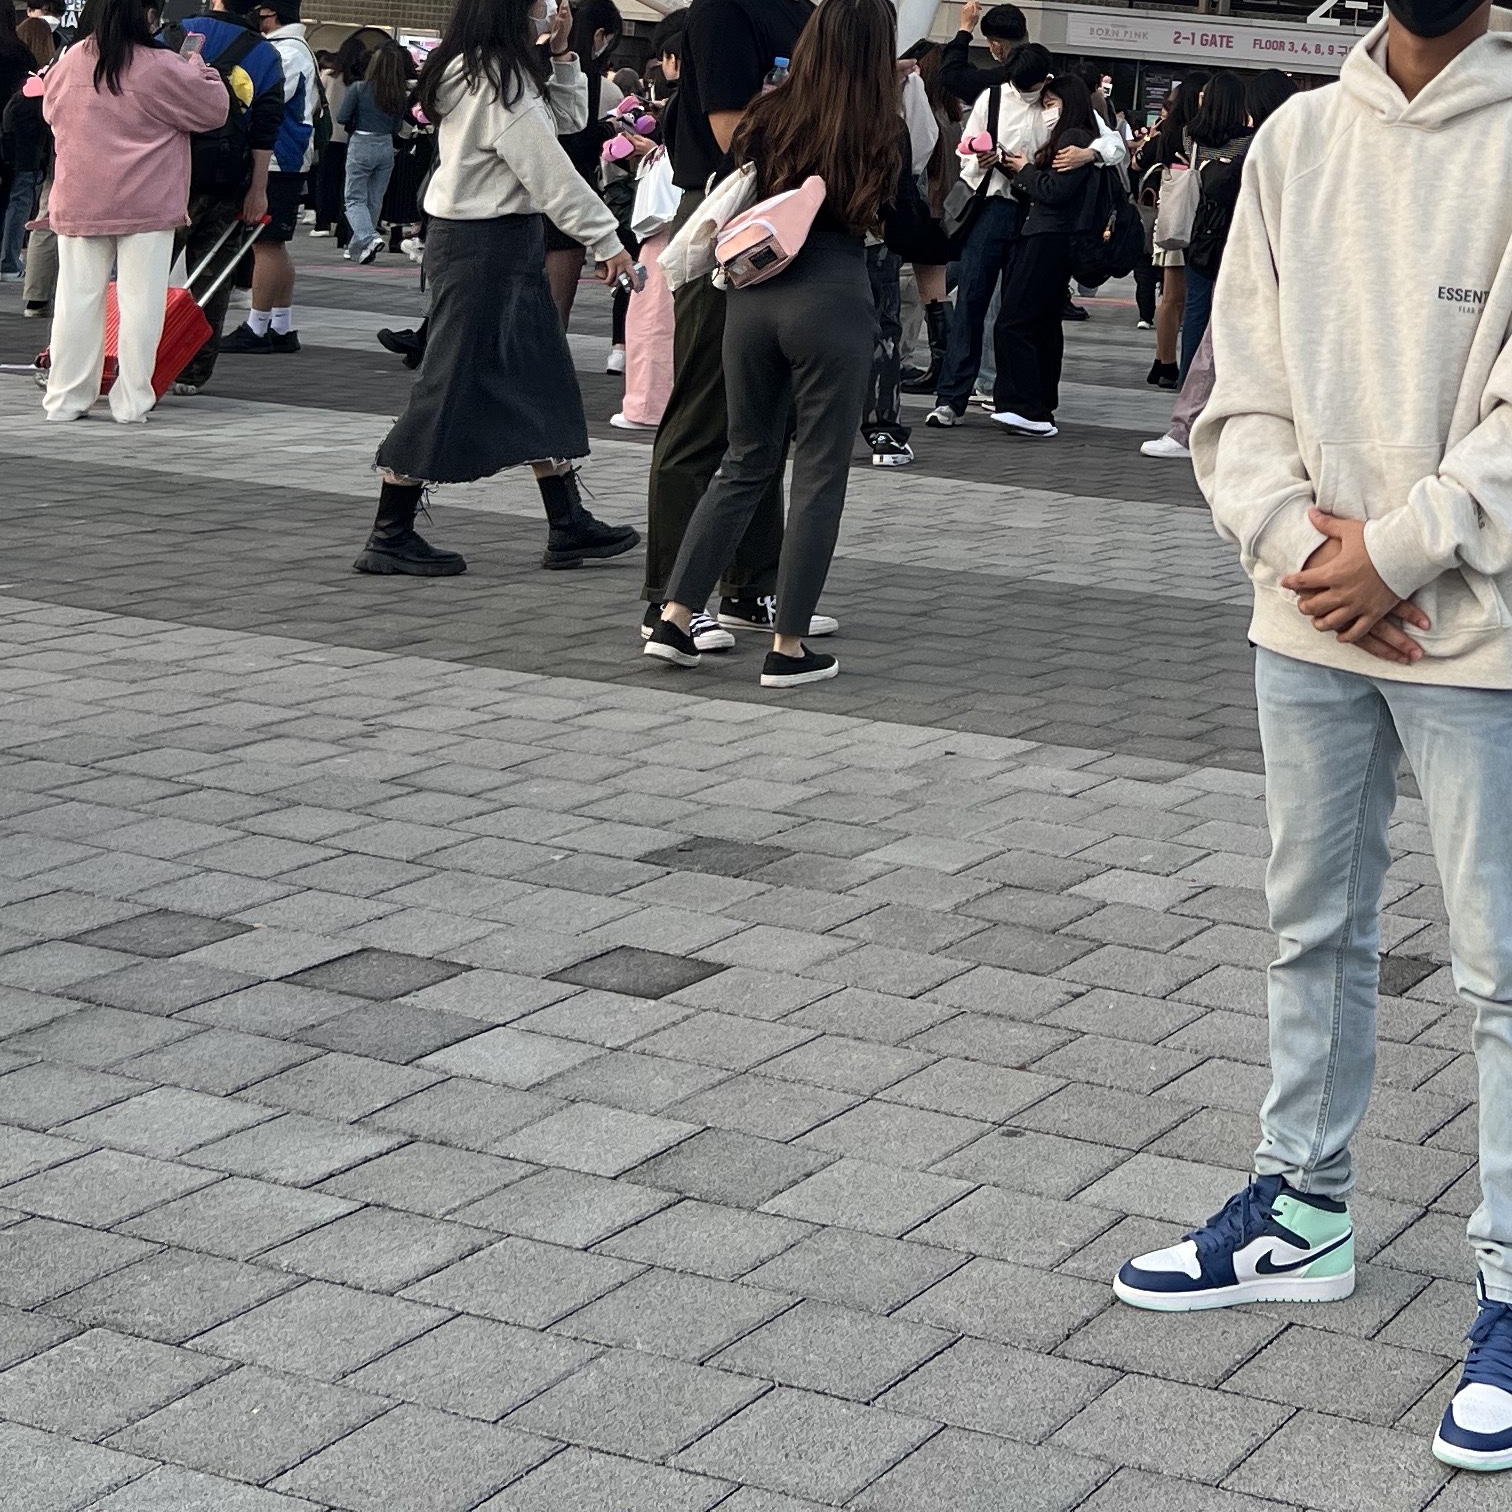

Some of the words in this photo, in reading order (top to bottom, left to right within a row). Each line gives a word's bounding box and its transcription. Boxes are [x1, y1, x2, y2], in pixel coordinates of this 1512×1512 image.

[1123, 31, 1149, 40] PINK
[1173, 31, 1196, 46] 2-1
[1200, 33, 1234, 49] GATE
[1253, 38, 1286, 51] FLOOR
[1288, 41, 1298, 54] 3,
[1301, 42, 1311, 54] 4,
[1327, 44, 1335, 56] 9
